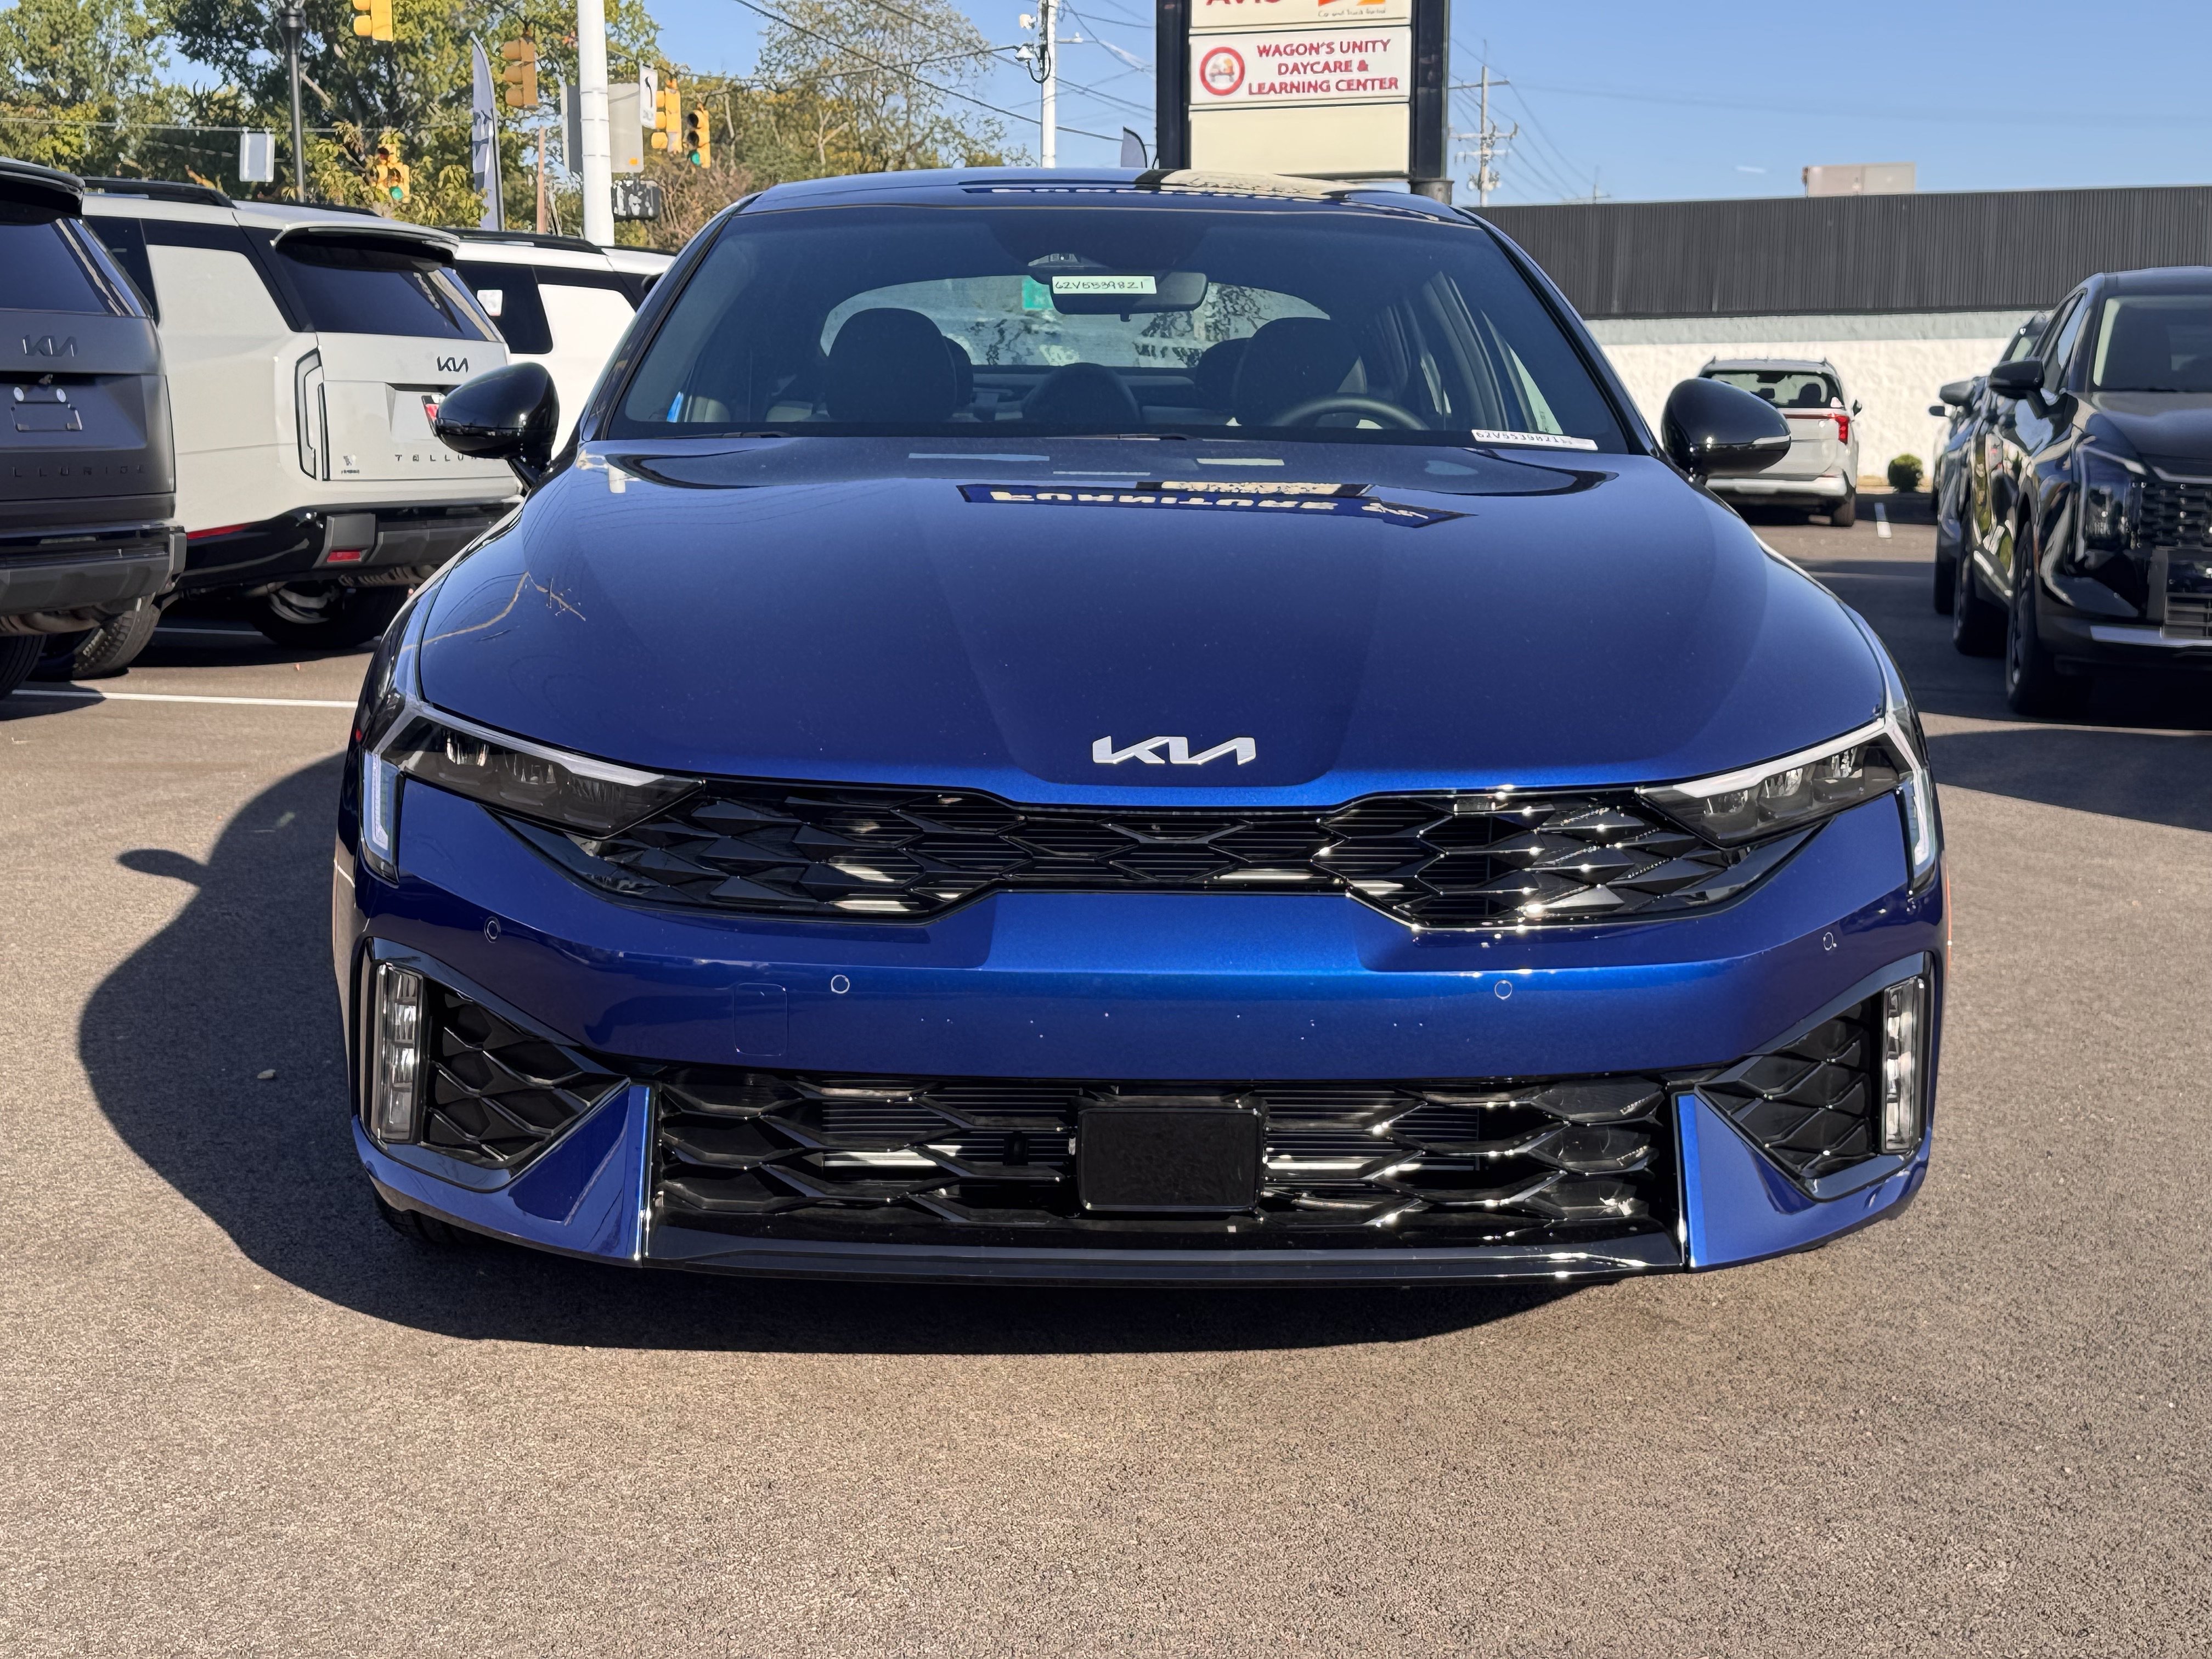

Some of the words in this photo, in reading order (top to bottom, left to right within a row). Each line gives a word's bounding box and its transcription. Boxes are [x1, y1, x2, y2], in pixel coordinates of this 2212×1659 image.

[1257, 42, 1335, 57] WAGON'S
[1340, 39, 1391, 53] UNITY
[1278, 60, 1353, 75] DAYCARE
[1357, 59, 1368, 72] &
[1248, 80, 1330, 95] LEARNING
[1335, 77, 1398, 91] CENTER
[437, 356, 469, 373] KIA
[1092, 736, 1256, 765] KIA
